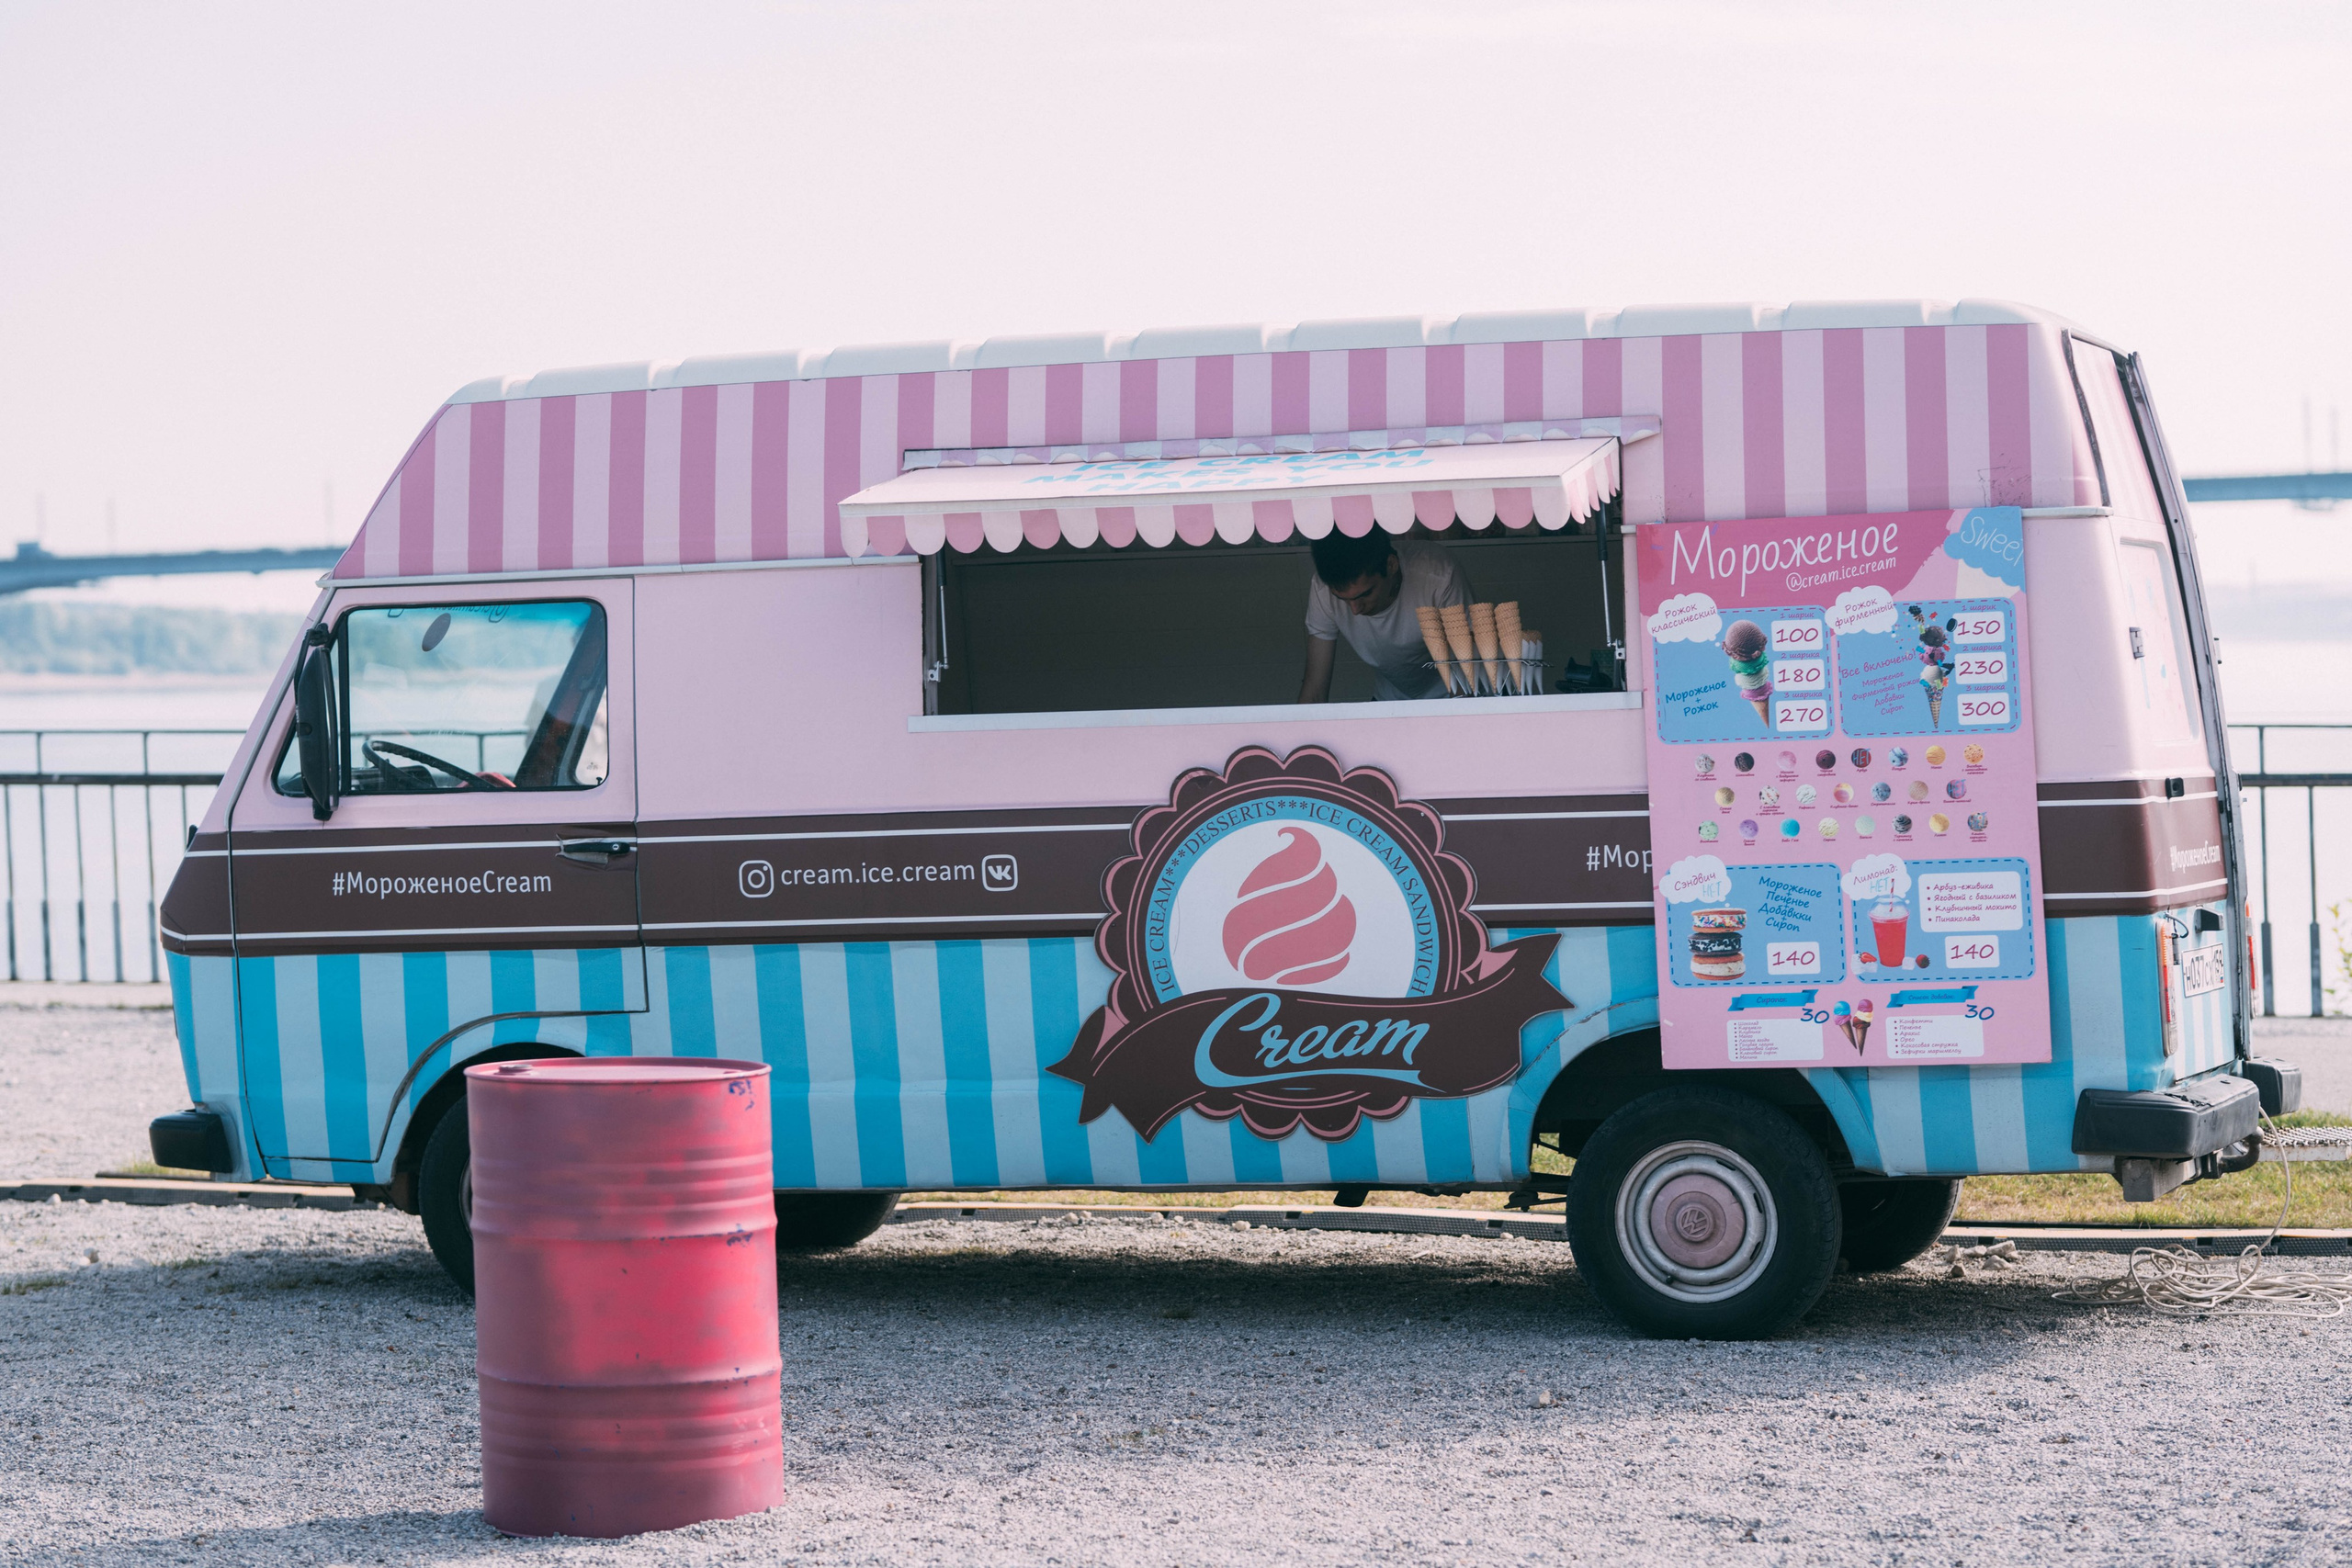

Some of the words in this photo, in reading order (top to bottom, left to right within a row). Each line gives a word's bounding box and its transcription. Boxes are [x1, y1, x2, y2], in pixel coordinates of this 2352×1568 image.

[1072, 461, 1176, 471] ICE
[1197, 450, 1424, 466] CREAM
[1022, 468, 1255, 484] MAKES
[1285, 459, 1434, 473] YOU
[1085, 475, 1329, 492] HAPPY
[1670, 523, 1898, 597] Мороженое
[1786, 557, 1896, 592] @cream.ice.cream
[1664, 604, 1698, 619] Рожок
[1835, 600, 1894, 628] фирменный
[1845, 598, 1878, 614] Рожок
[1651, 606, 1717, 634] классический
[1957, 620, 2001, 636] 150
[1775, 627, 1819, 643] 100
[1790, 652, 1821, 660] шарика
[1972, 645, 2003, 653] шарика
[1841, 668, 1860, 679] Все
[1863, 649, 1917, 672] включено!
[1959, 660, 2004, 676] 230
[1778, 668, 1821, 682] 180
[1862, 671, 1904, 687] Мороженое
[1666, 681, 1727, 704] Мороженое
[1792, 692, 1824, 700] шарика
[1975, 684, 2006, 693] шарика
[1683, 701, 1719, 716] Рожок
[1780, 707, 1824, 724] 270
[1881, 705, 1904, 715] Сироп
[1962, 701, 2006, 716] 300
[781, 862, 976, 886] cream.ice.cream
[1674, 873, 1716, 891] Сэндвич
[1853, 863, 1898, 886] Лимонад:
[332, 870, 552, 899] #МороженоеCream
[1702, 880, 1722, 897] НЕТ
[1758, 875, 1822, 898] Мороженое
[1870, 876, 1890, 893] НЕТ
[1766, 890, 1810, 908] Печенье
[1935, 904, 1983, 913] Клубничный
[1765, 917, 1800, 932] Сироп
[1935, 914, 1981, 922] Пинаколада
[1772, 951, 1815, 966] 140
[1951, 944, 1995, 960] 140
[1801, 1008, 1829, 1023] 30
[1965, 1004, 1995, 1021] 30
[1194, 993, 1444, 1092] Cream
